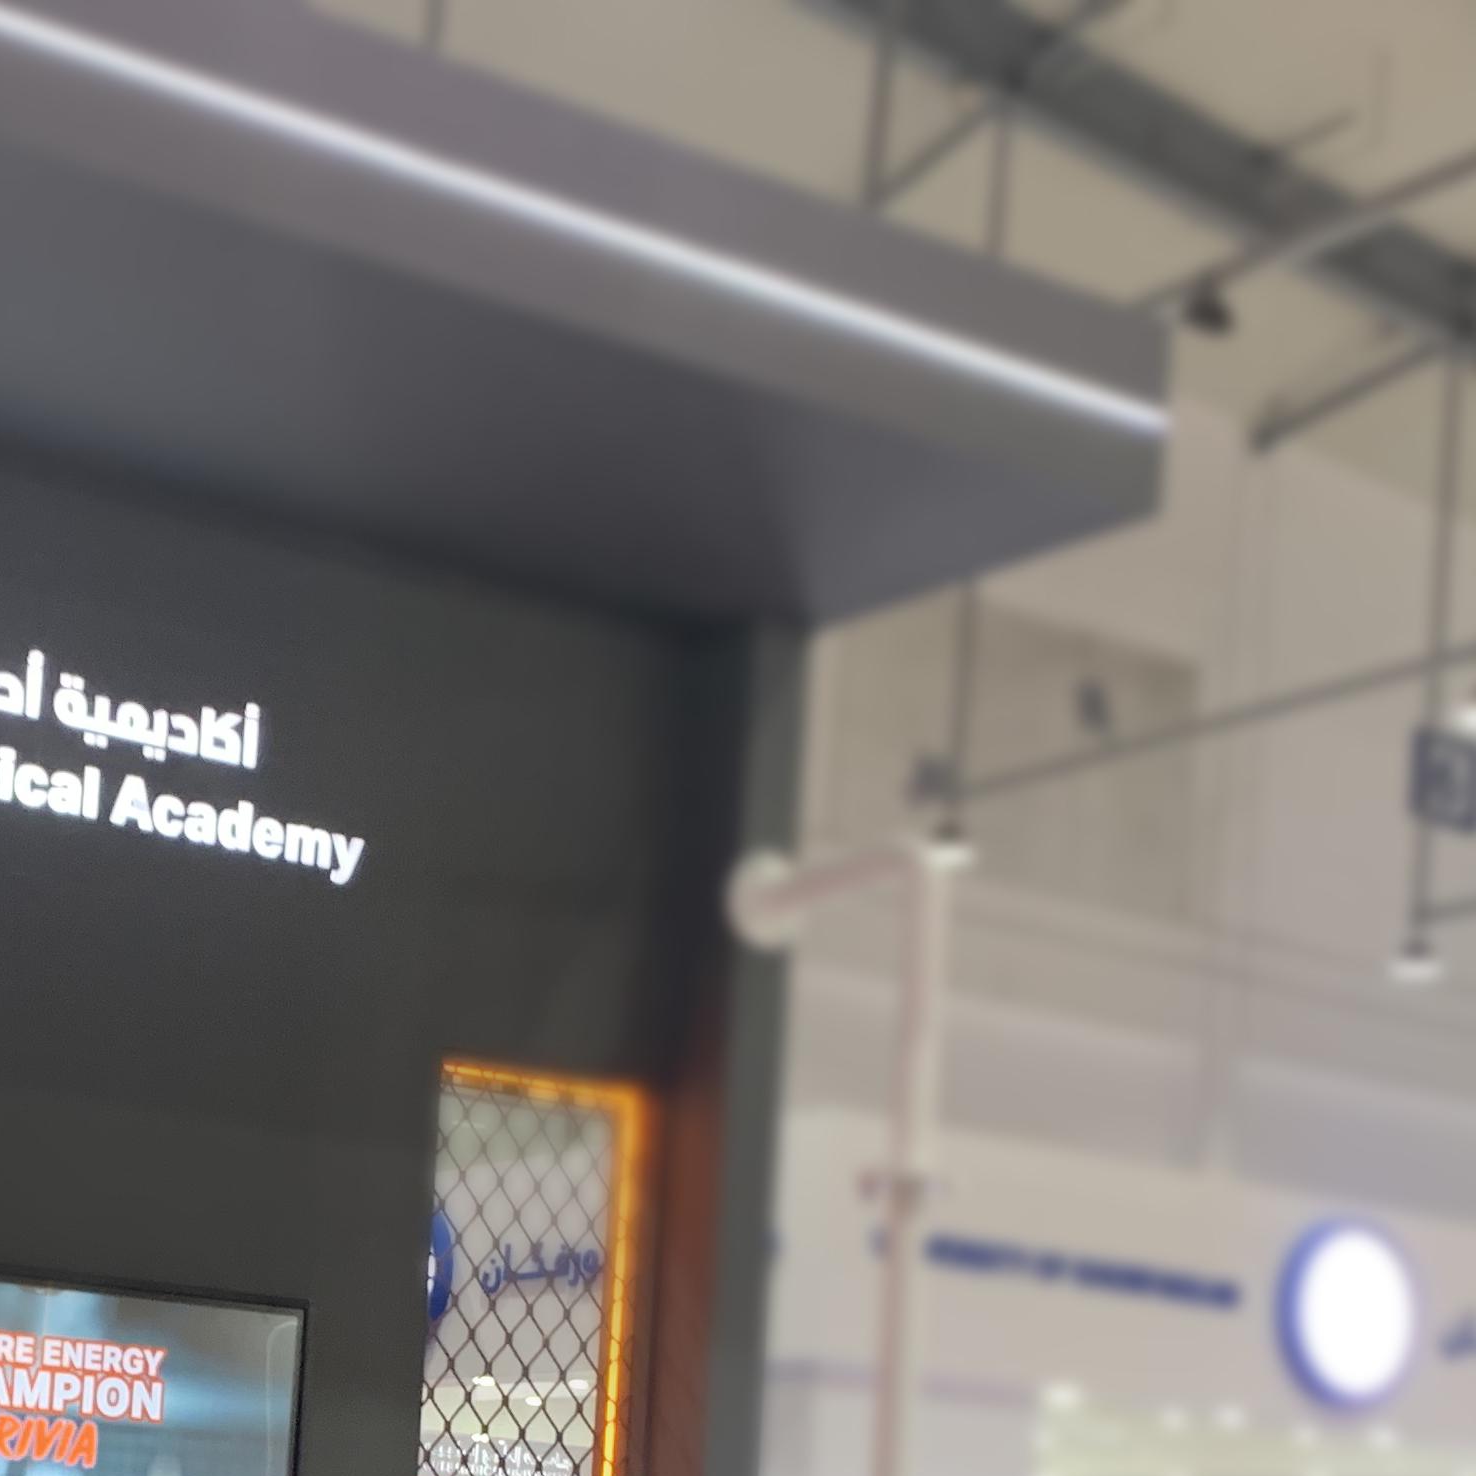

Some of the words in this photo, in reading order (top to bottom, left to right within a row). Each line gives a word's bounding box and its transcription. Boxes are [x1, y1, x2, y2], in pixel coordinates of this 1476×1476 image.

[54, 672, 260, 769] أكاديمية
[110, 774, 365, 885] Academy
[43, 1339, 164, 1377] ENERGY
